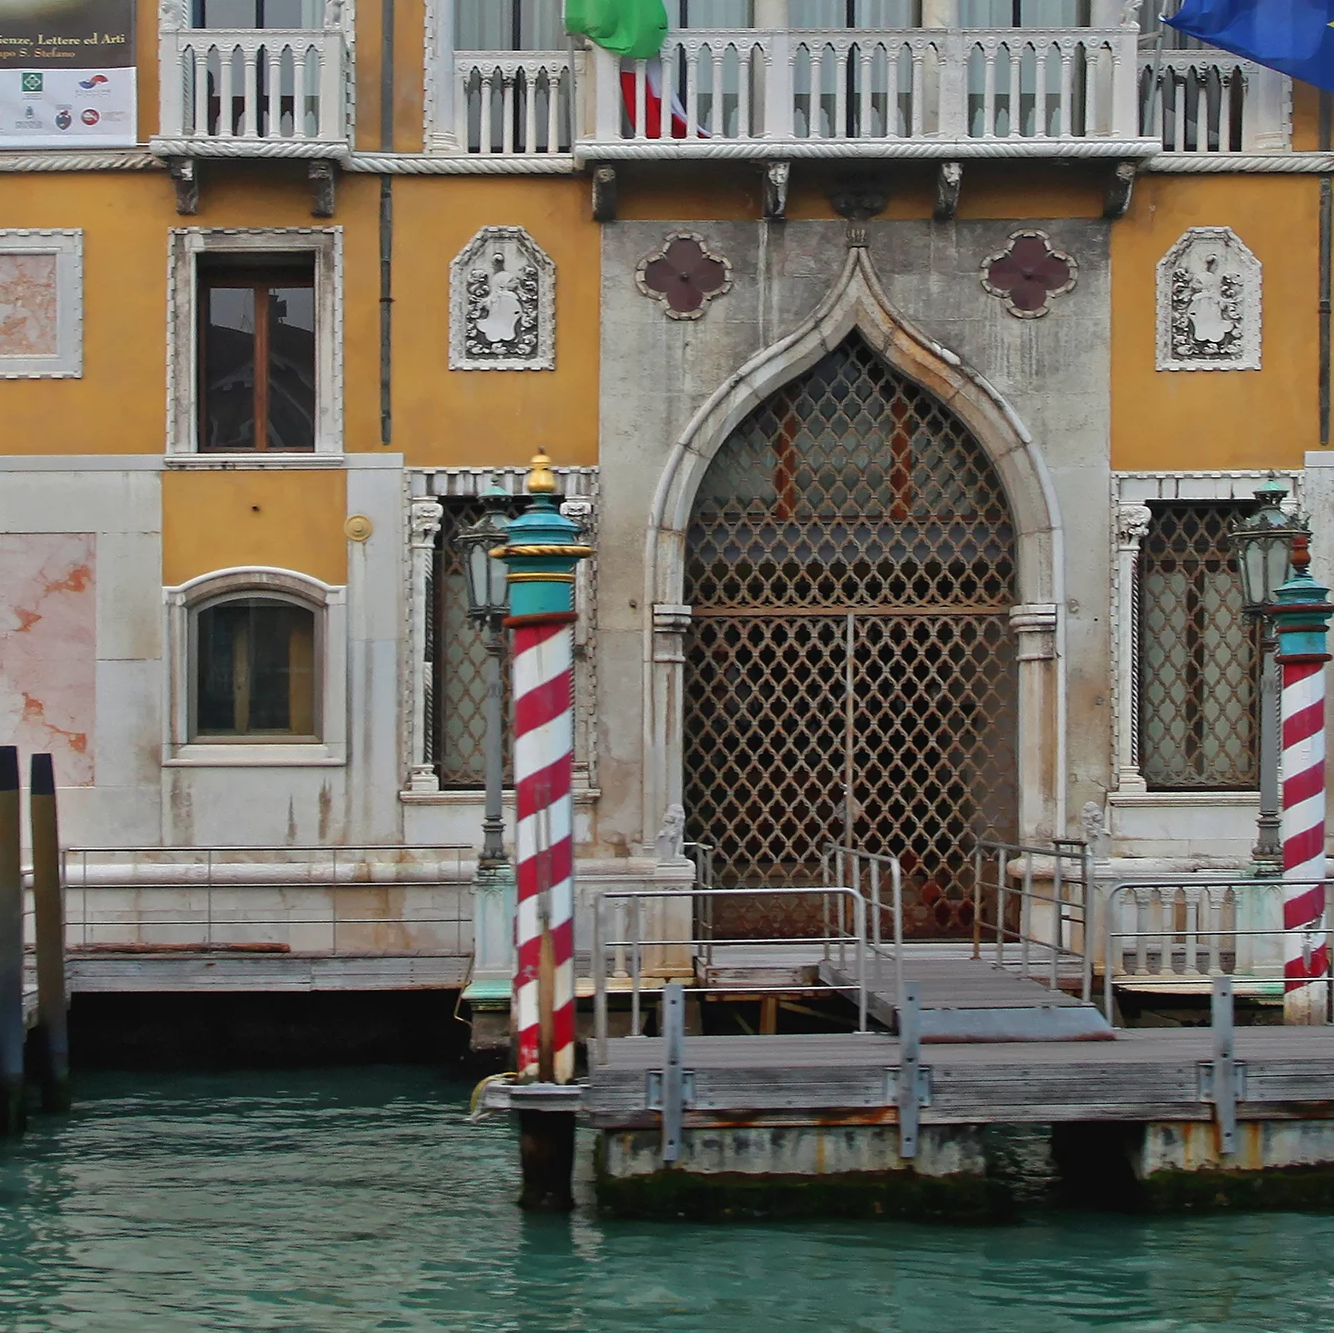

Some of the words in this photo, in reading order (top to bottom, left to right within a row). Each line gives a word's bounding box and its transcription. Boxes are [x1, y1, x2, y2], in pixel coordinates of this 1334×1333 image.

[38, 33, 81, 45] Lettere
[83, 32, 98, 45] ed
[101, 33, 125, 45] Arti
